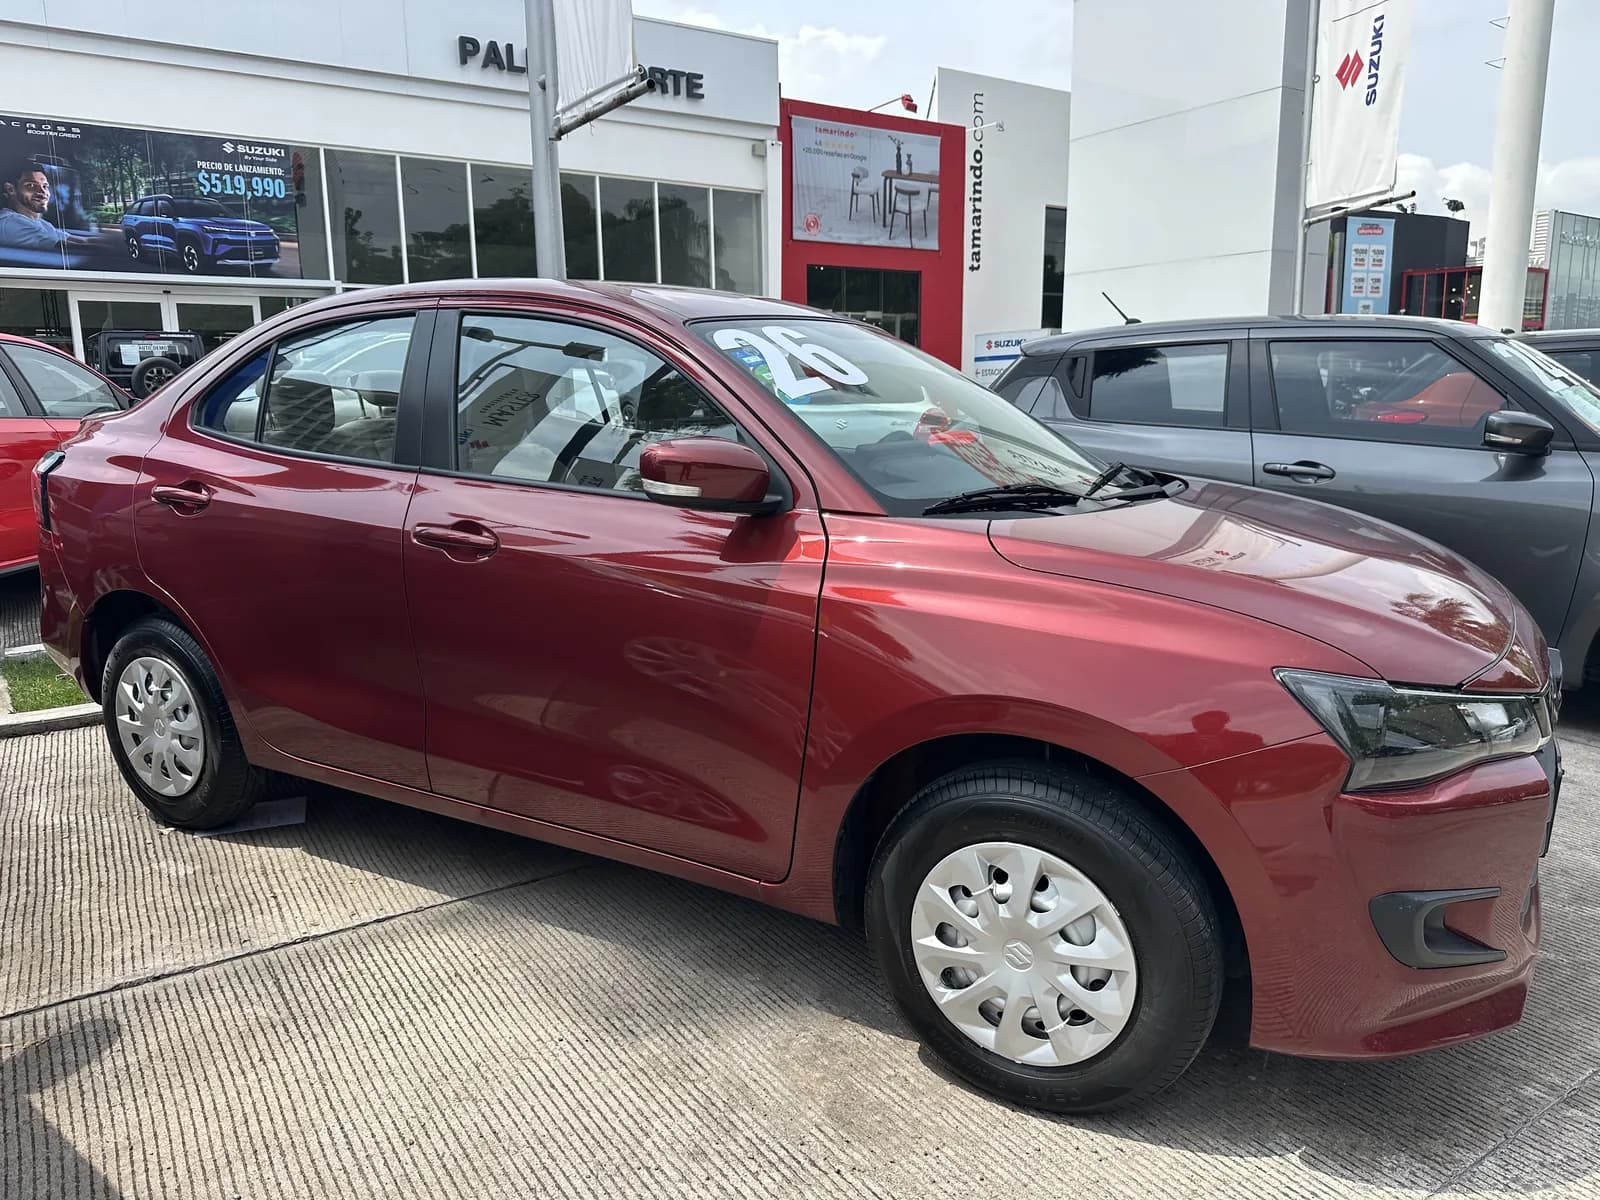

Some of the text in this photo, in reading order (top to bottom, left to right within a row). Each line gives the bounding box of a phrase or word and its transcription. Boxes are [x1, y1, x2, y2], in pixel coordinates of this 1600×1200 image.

[458, 35, 528, 75] PAL
[1366, 14, 1385, 106] SUZUKI
[197, 160, 285, 176] PRECIO DE LANZAMIENTO:
[236, 144, 285, 157] SUZUKI
[198, 169, 286, 200] $519,990
[969, 93, 984, 272] tamarindo.com
[994, 339, 1026, 348] SUZUK
[713, 326, 869, 399] 26
